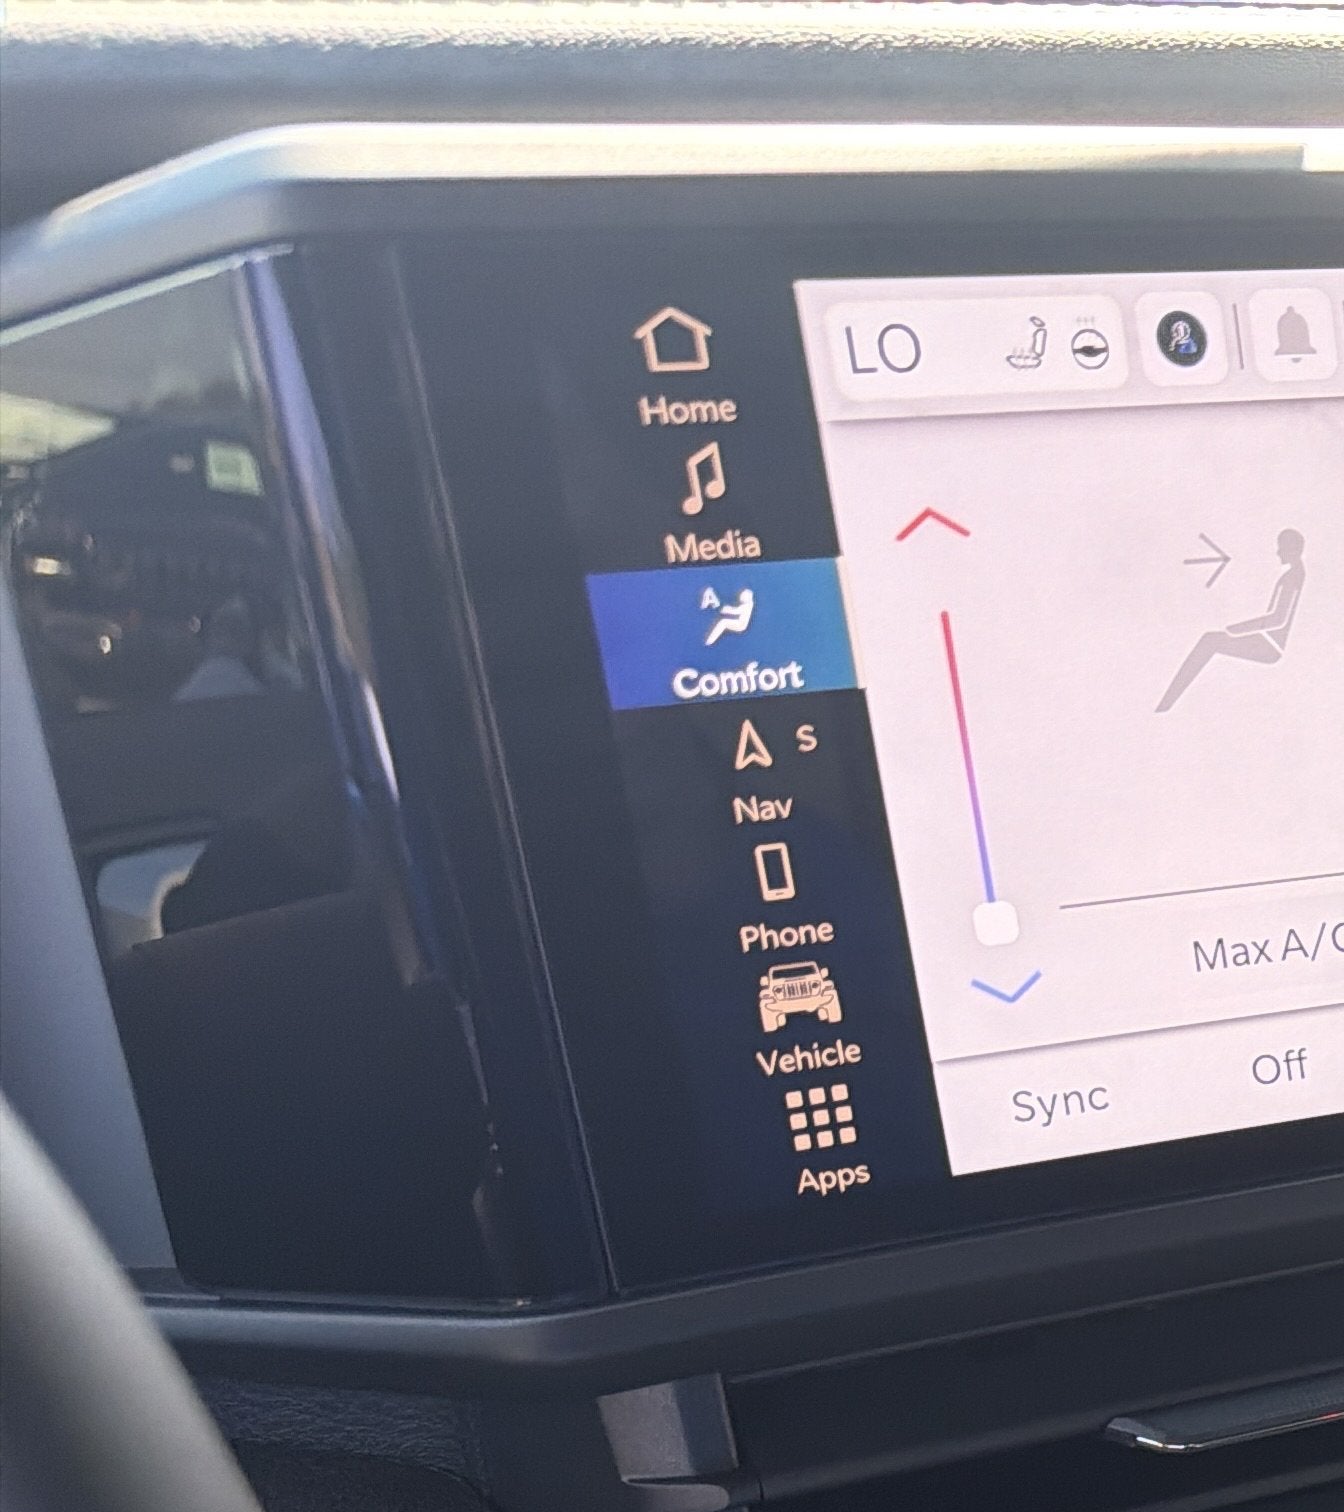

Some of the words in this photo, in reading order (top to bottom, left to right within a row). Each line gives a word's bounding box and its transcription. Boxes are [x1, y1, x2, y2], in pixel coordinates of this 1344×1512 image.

[845, 323, 922, 375] LO
[639, 396, 738, 427] Home
[664, 528, 762, 565] Media
[672, 660, 805, 700] Comfort
[795, 724, 818, 753] S
[733, 795, 794, 826] Nav
[739, 919, 835, 954] Phone
[1192, 936, 1271, 973] Max
[755, 1038, 863, 1077] Vehicle
[1251, 1047, 1309, 1086] Off
[1011, 1084, 1111, 1128] Sync
[797, 1163, 872, 1197] Apps
